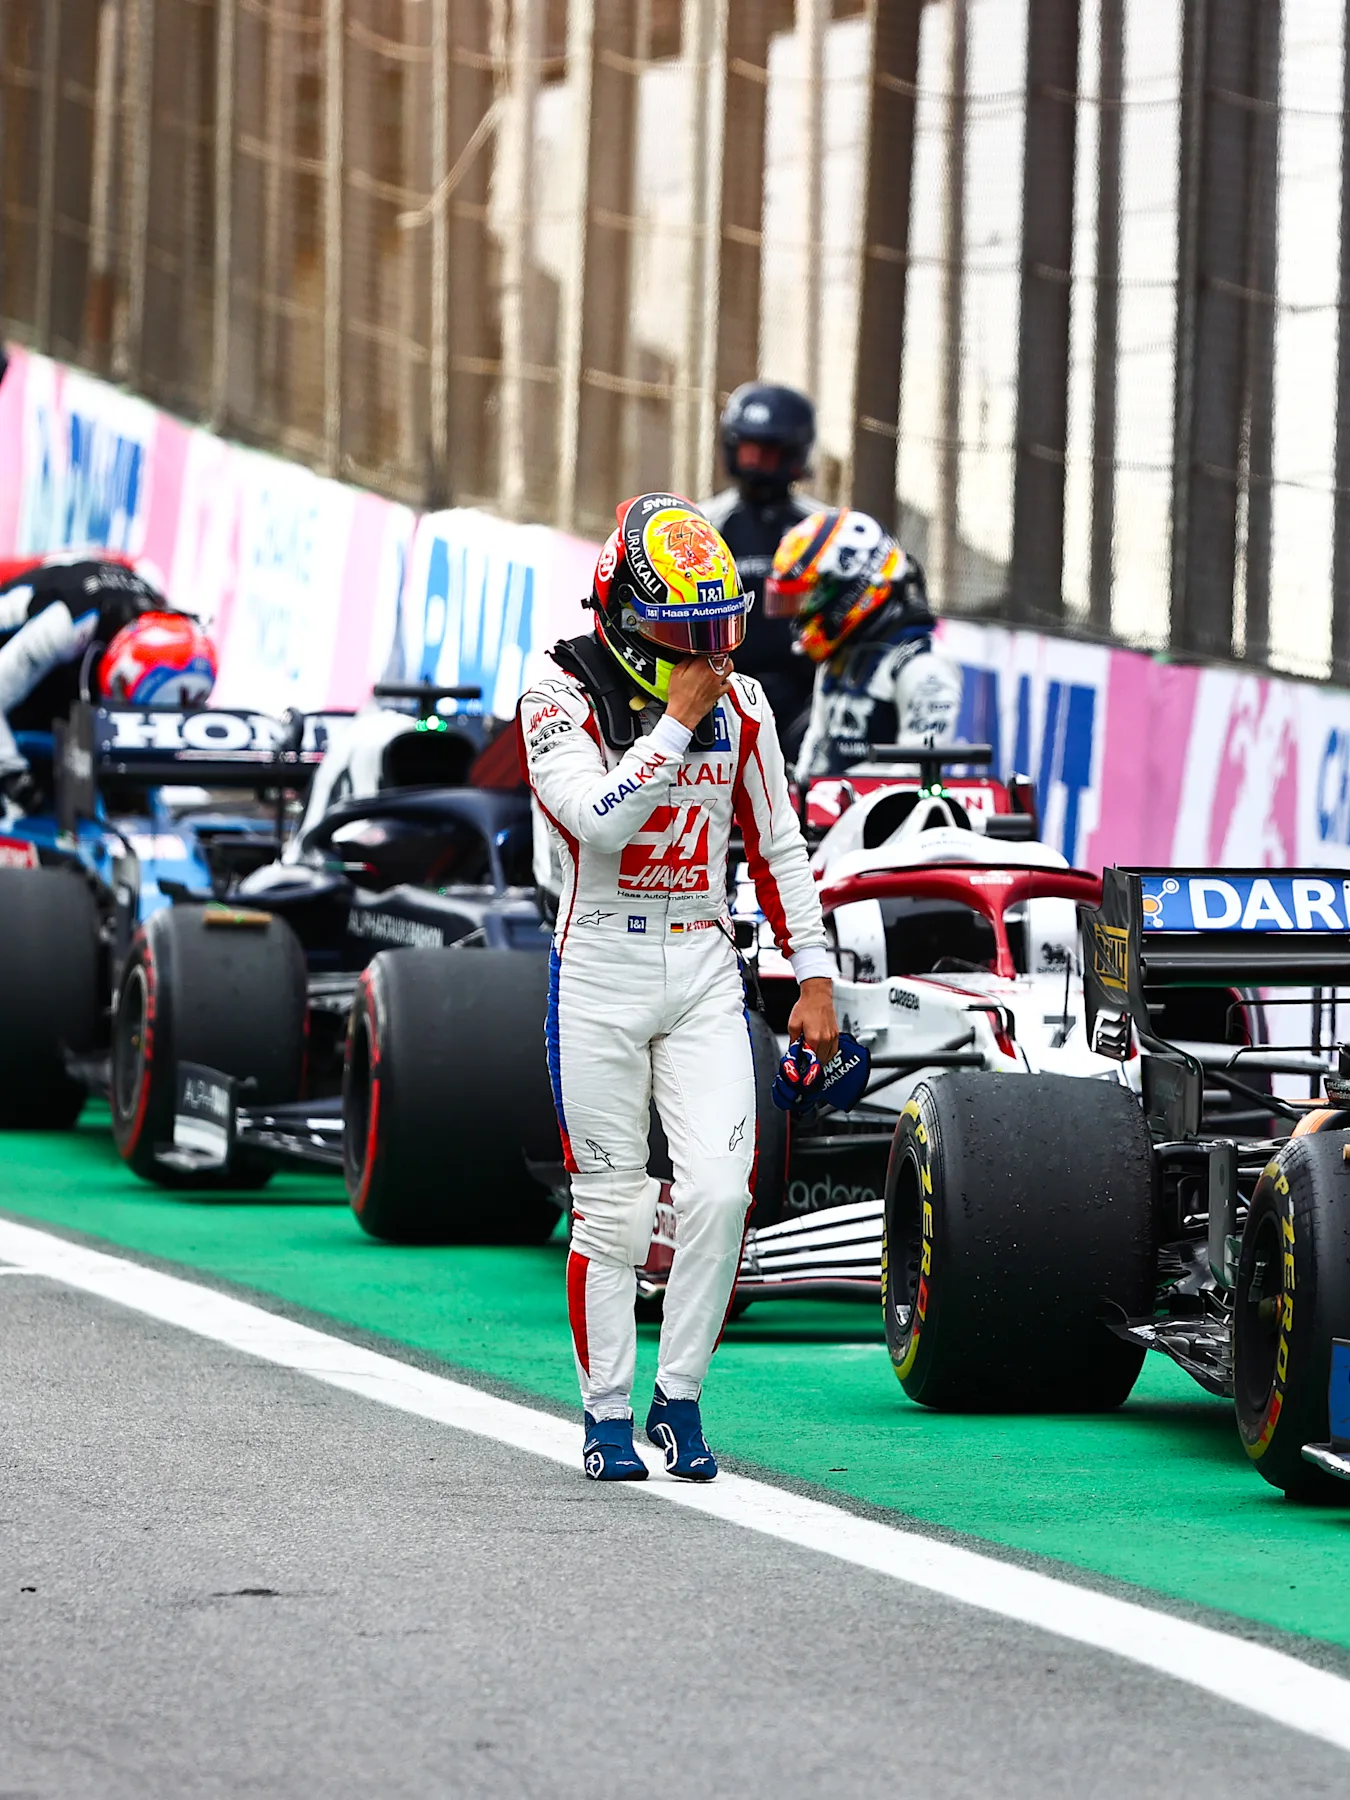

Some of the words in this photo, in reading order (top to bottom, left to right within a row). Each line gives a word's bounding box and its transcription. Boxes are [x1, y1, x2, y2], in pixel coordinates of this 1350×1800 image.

[626, 528, 663, 595] URALKALI
[699, 585, 724, 604] 1&1
[662, 609, 690, 618] Haas
[692, 602, 739, 617] Automation
[527, 704, 560, 735] HAAS
[592, 752, 667, 817] URALKALI
[618, 864, 708, 889] HAAS
[617, 890, 642, 899] Haas
[629, 918, 645, 930] 1&1
[888, 986, 921, 1012] CARRERA
[1042, 1014, 1077, 1048] 7
[1274, 1175, 1290, 1196] P
[919, 1163, 934, 1322] ZERO
[1276, 1213, 1297, 1385] ZERO
